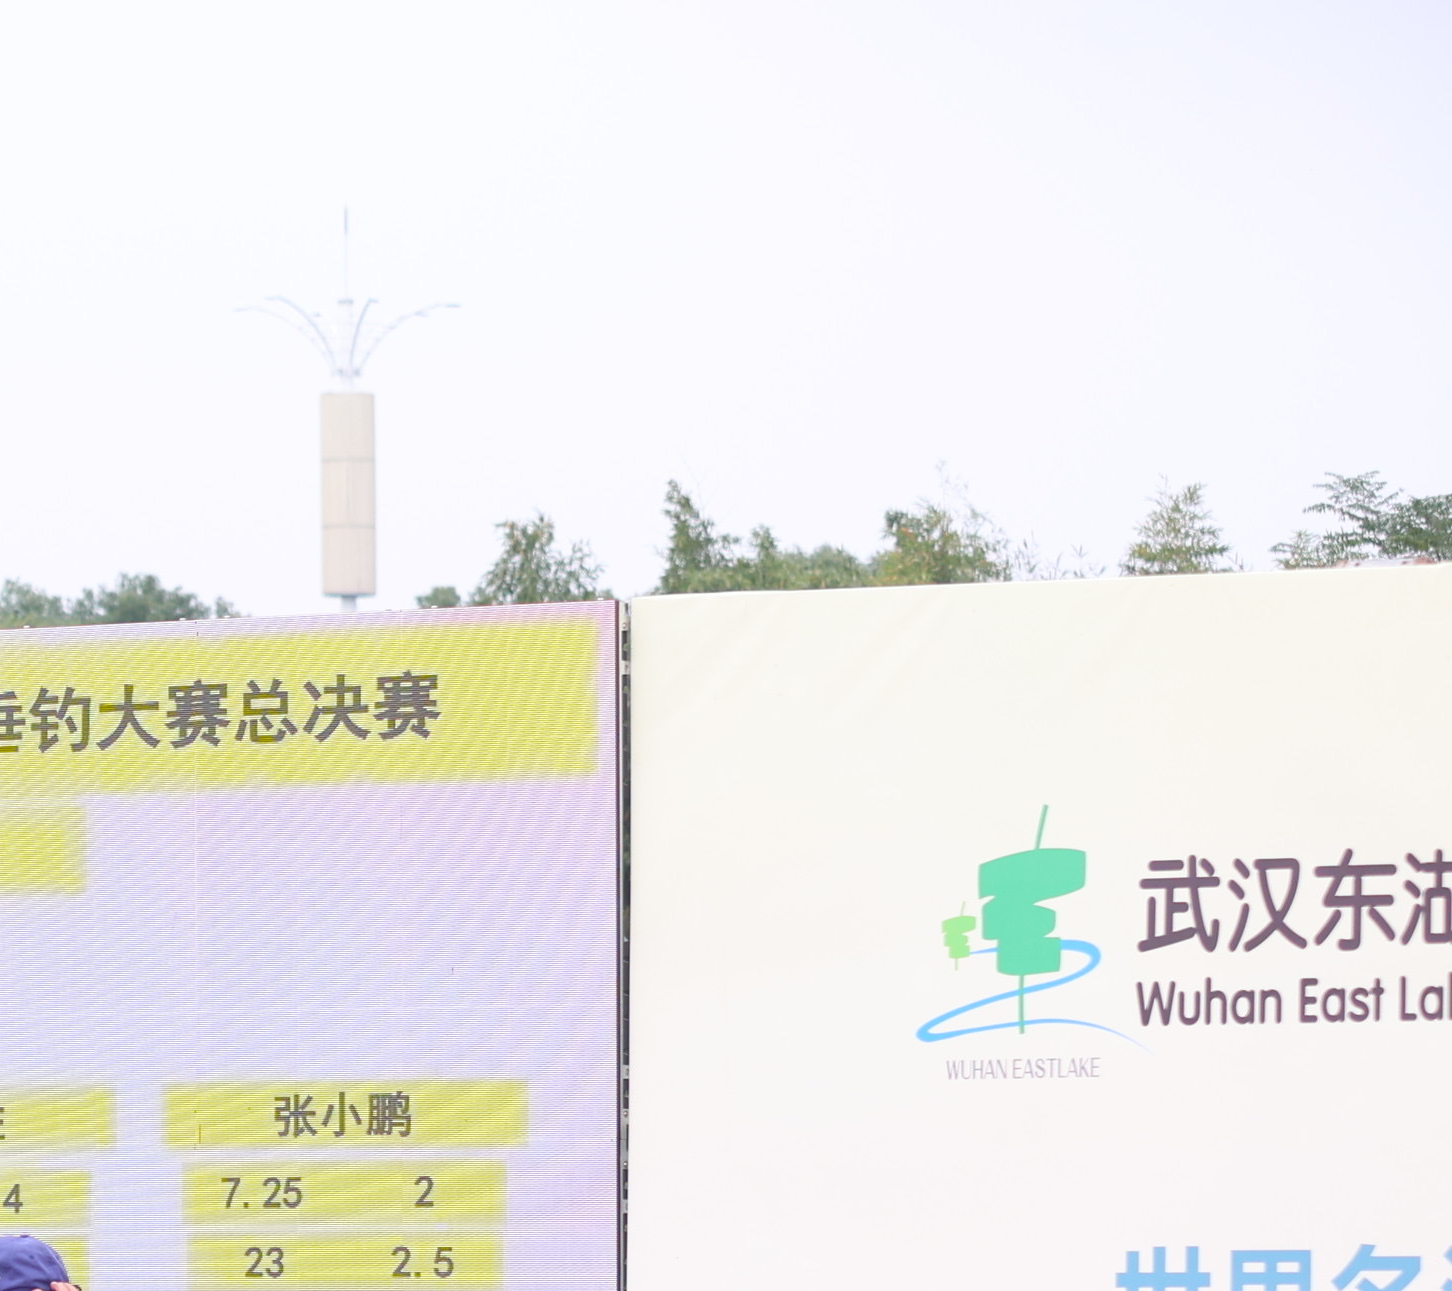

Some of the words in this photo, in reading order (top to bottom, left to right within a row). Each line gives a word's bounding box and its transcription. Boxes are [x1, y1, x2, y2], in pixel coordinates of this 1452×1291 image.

[1136, 976, 1282, 1026] Wuhan
[1299, 977, 1385, 1024] East
[1399, 975, 1452, 1021] La
[946, 1059, 1007, 1080] WUHAN
[273, 1091, 412, 1138] 张小鹏
[2, 1183, 23, 1213] 4
[220, 1176, 304, 1209] 7.25
[413, 1176, 435, 1208] 2
[245, 1247, 285, 1277] 23
[391, 1247, 455, 1278] 2.5
